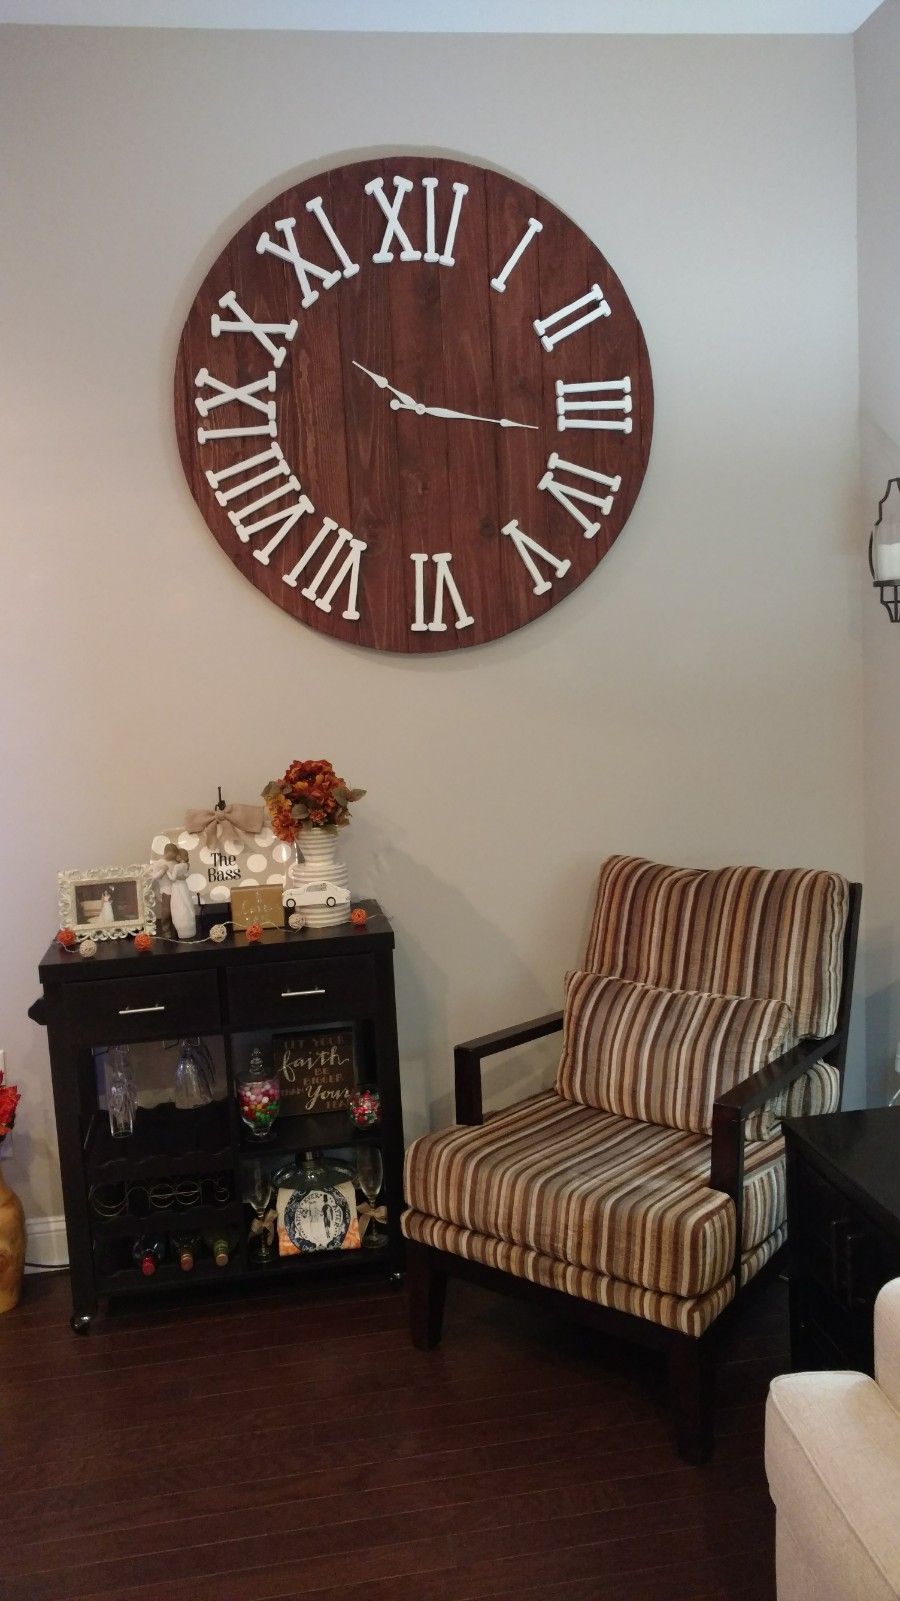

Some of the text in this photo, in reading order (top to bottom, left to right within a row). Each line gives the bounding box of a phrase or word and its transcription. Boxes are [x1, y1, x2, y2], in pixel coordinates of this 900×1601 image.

[257, 196, 360, 309] XI
[365, 176, 469, 267] XII
[490, 217, 543, 293] I
[211, 290, 298, 368] X
[533, 283, 612, 352] II
[195, 368, 278, 445] IX
[555, 376, 632, 433] III
[206, 441, 314, 566] VIII
[537, 452, 622, 539] IV
[282, 517, 366, 621] VII
[411, 552, 474, 632] VI
[500, 519, 572, 595] V
[208, 868, 242, 883] Bass
[210, 852, 237, 867] The
[277, 1045, 350, 1083] faith
